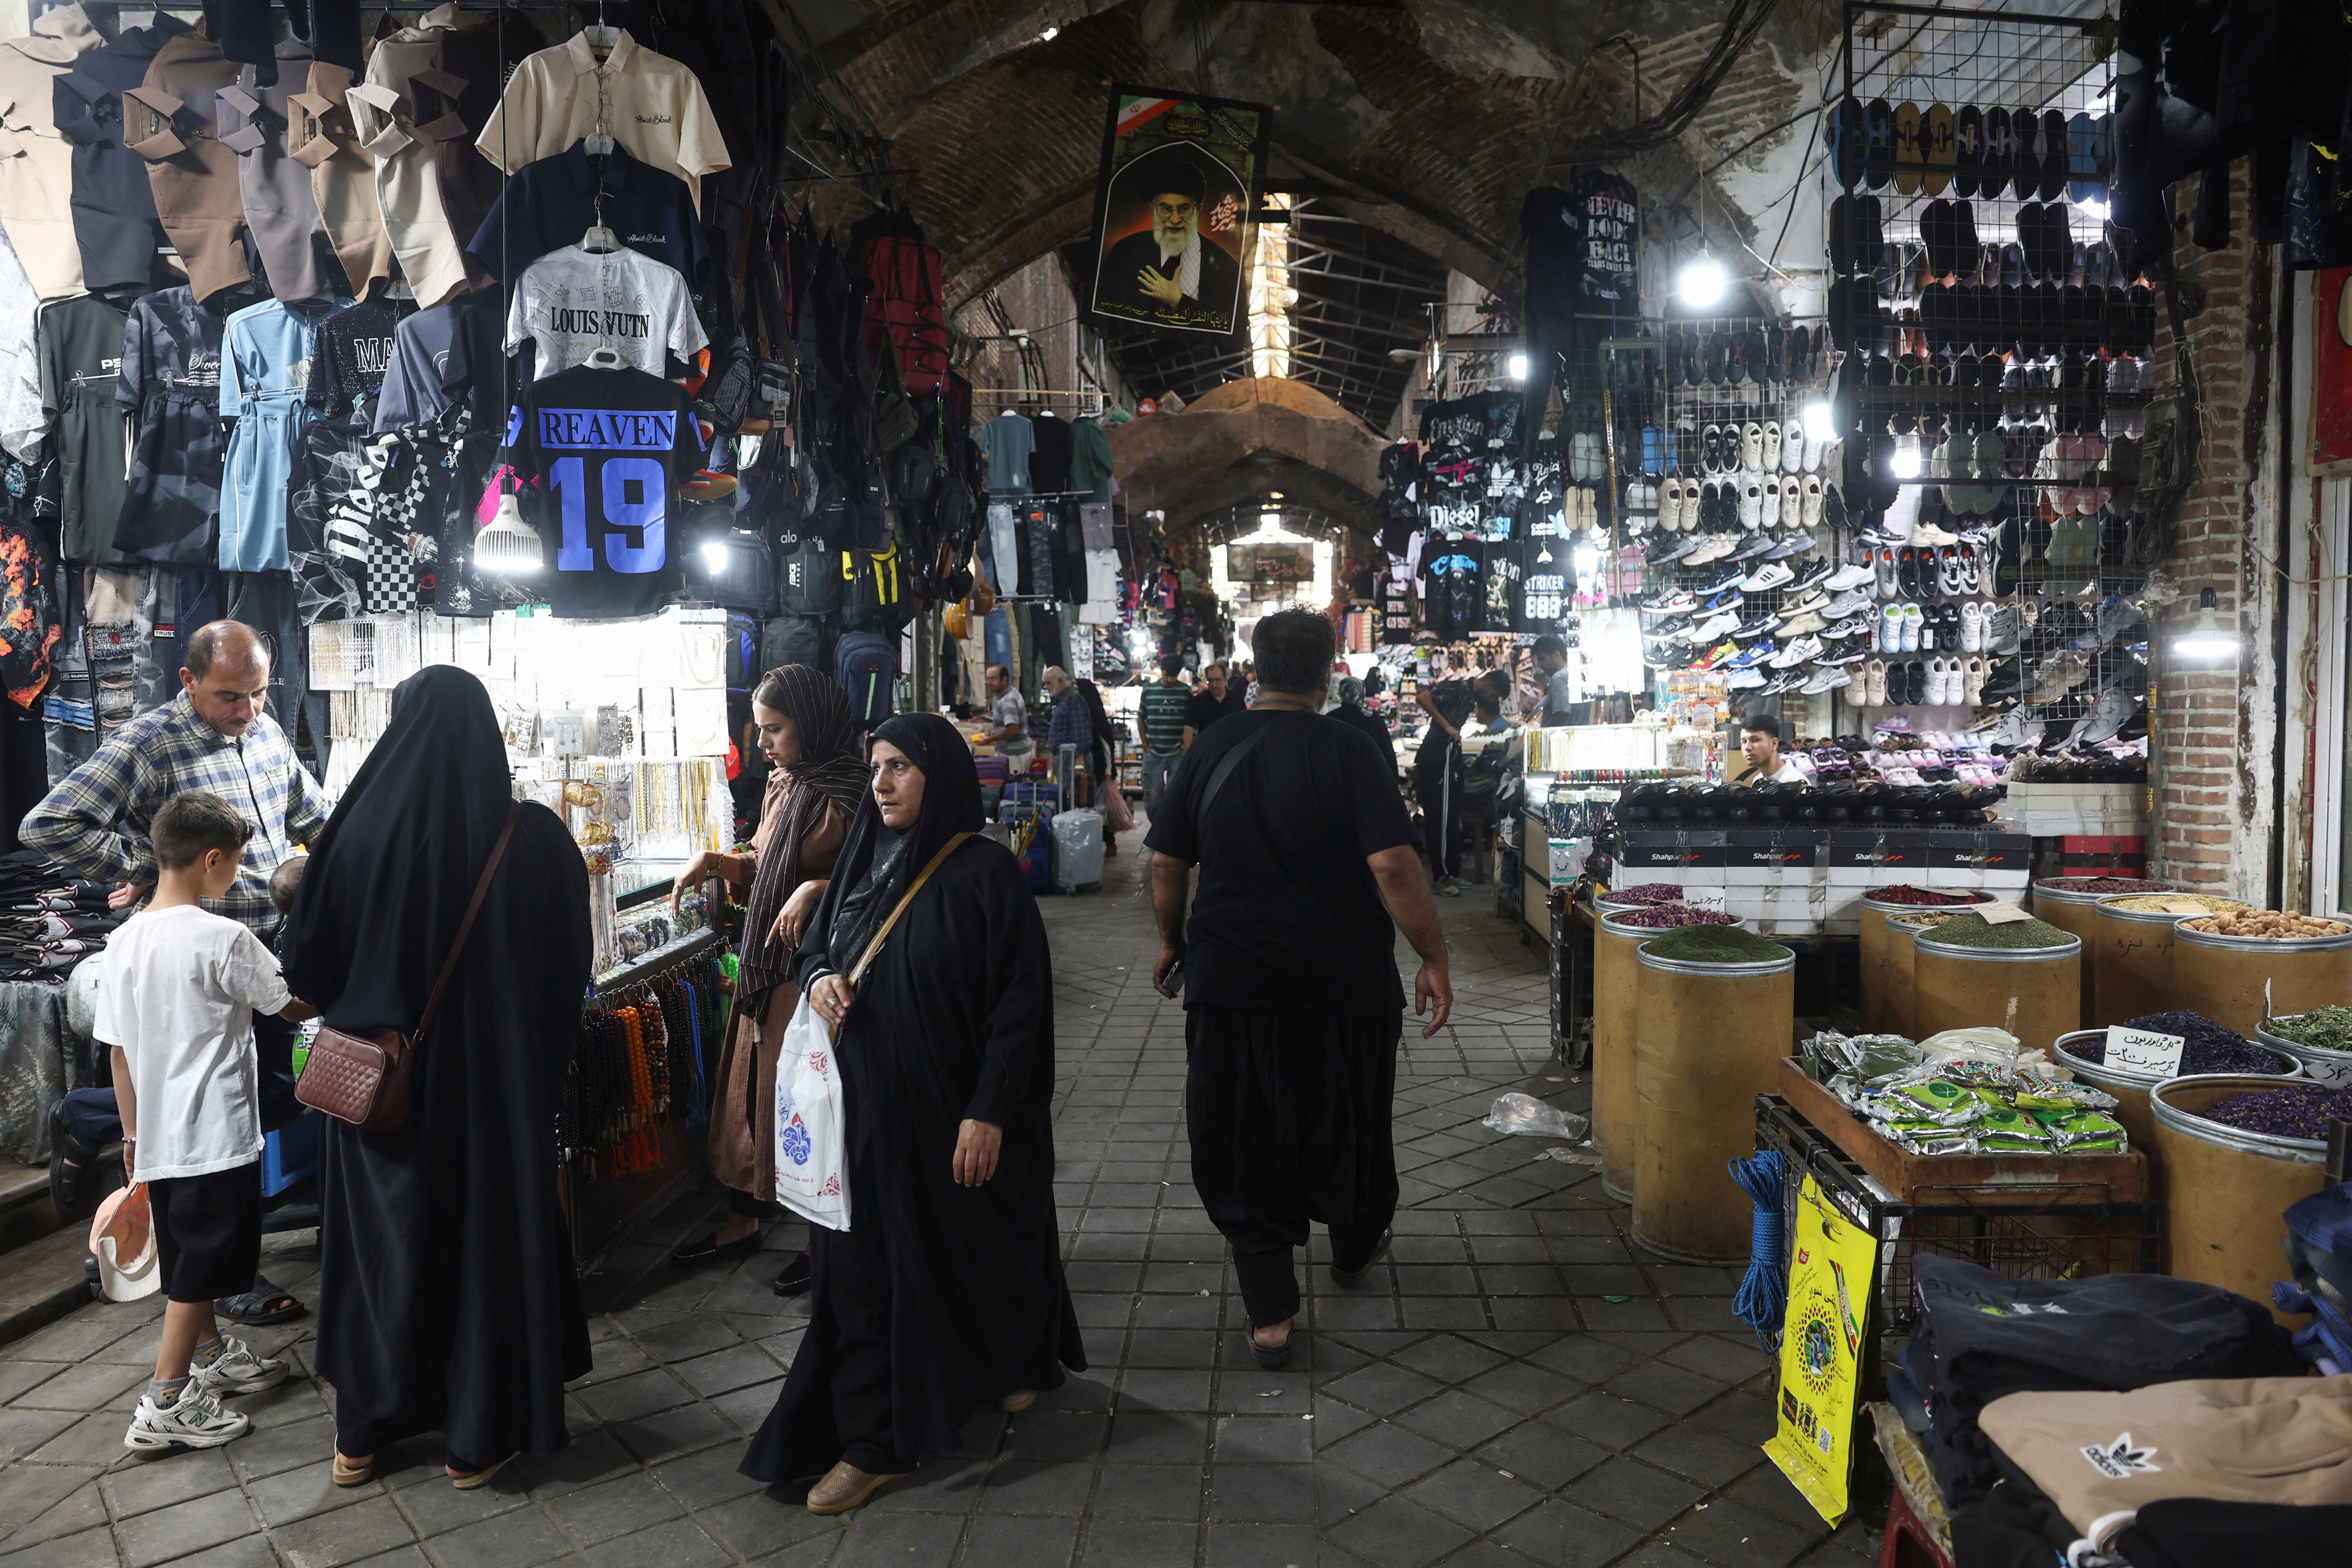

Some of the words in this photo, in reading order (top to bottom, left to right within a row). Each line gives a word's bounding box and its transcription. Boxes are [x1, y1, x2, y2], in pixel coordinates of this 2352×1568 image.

[652, 115, 673, 125] Blank
[645, 234, 667, 243] Blank
[551, 307, 599, 334] LOUIS
[541, 413, 674, 446] REAVEN
[549, 457, 666, 573] 19
[1430, 505, 1479, 528] Diesel
[780, 529, 797, 543] alo
[1524, 574, 1564, 590] STRIKER
[1526, 595, 1561, 619] 888
